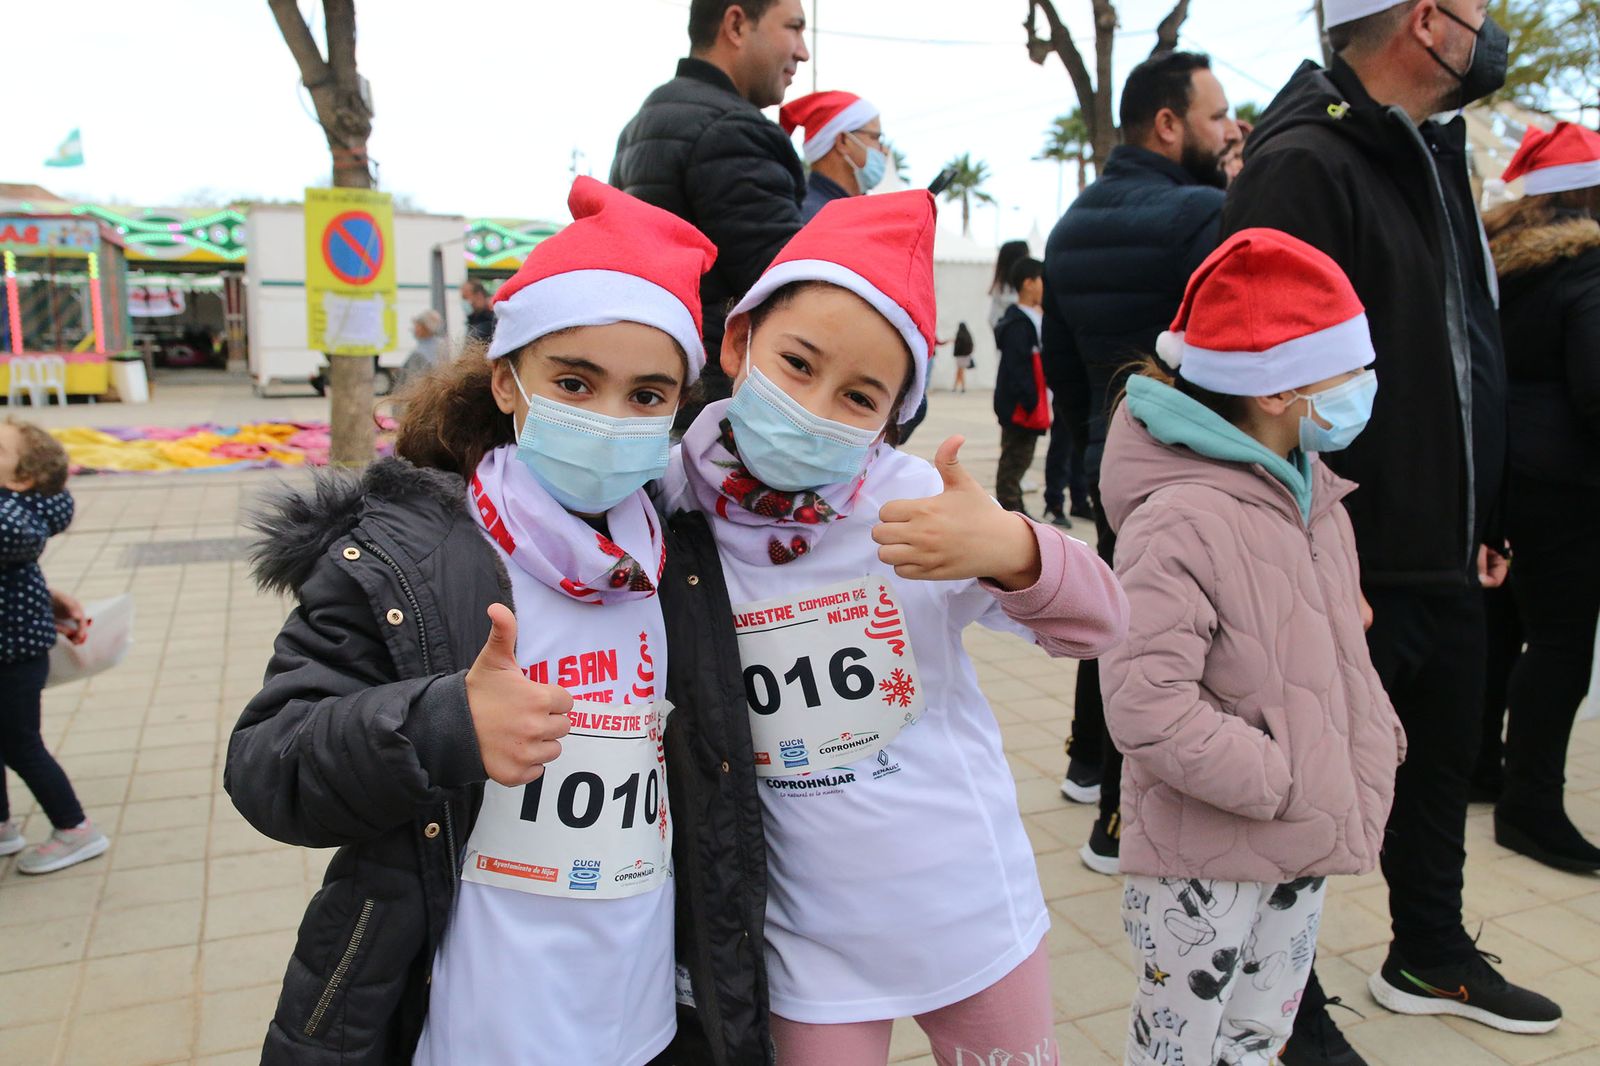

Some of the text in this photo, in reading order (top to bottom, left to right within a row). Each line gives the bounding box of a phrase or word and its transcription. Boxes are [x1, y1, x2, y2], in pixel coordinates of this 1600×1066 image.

[798, 592, 850, 612] COMARCA
[827, 605, 869, 624] NÍJAR
[558, 649, 618, 688] SAN
[567, 711, 641, 731] SILVESTRE
[779, 738, 804, 748] CUCN
[819, 734, 880, 755] COPROHNÍJAR
[872, 763, 899, 777] RENAULT
[766, 773, 856, 790] COPROHNÍJAR
[520, 766, 658, 829] 1010
[573, 859, 600, 867] CUCN
